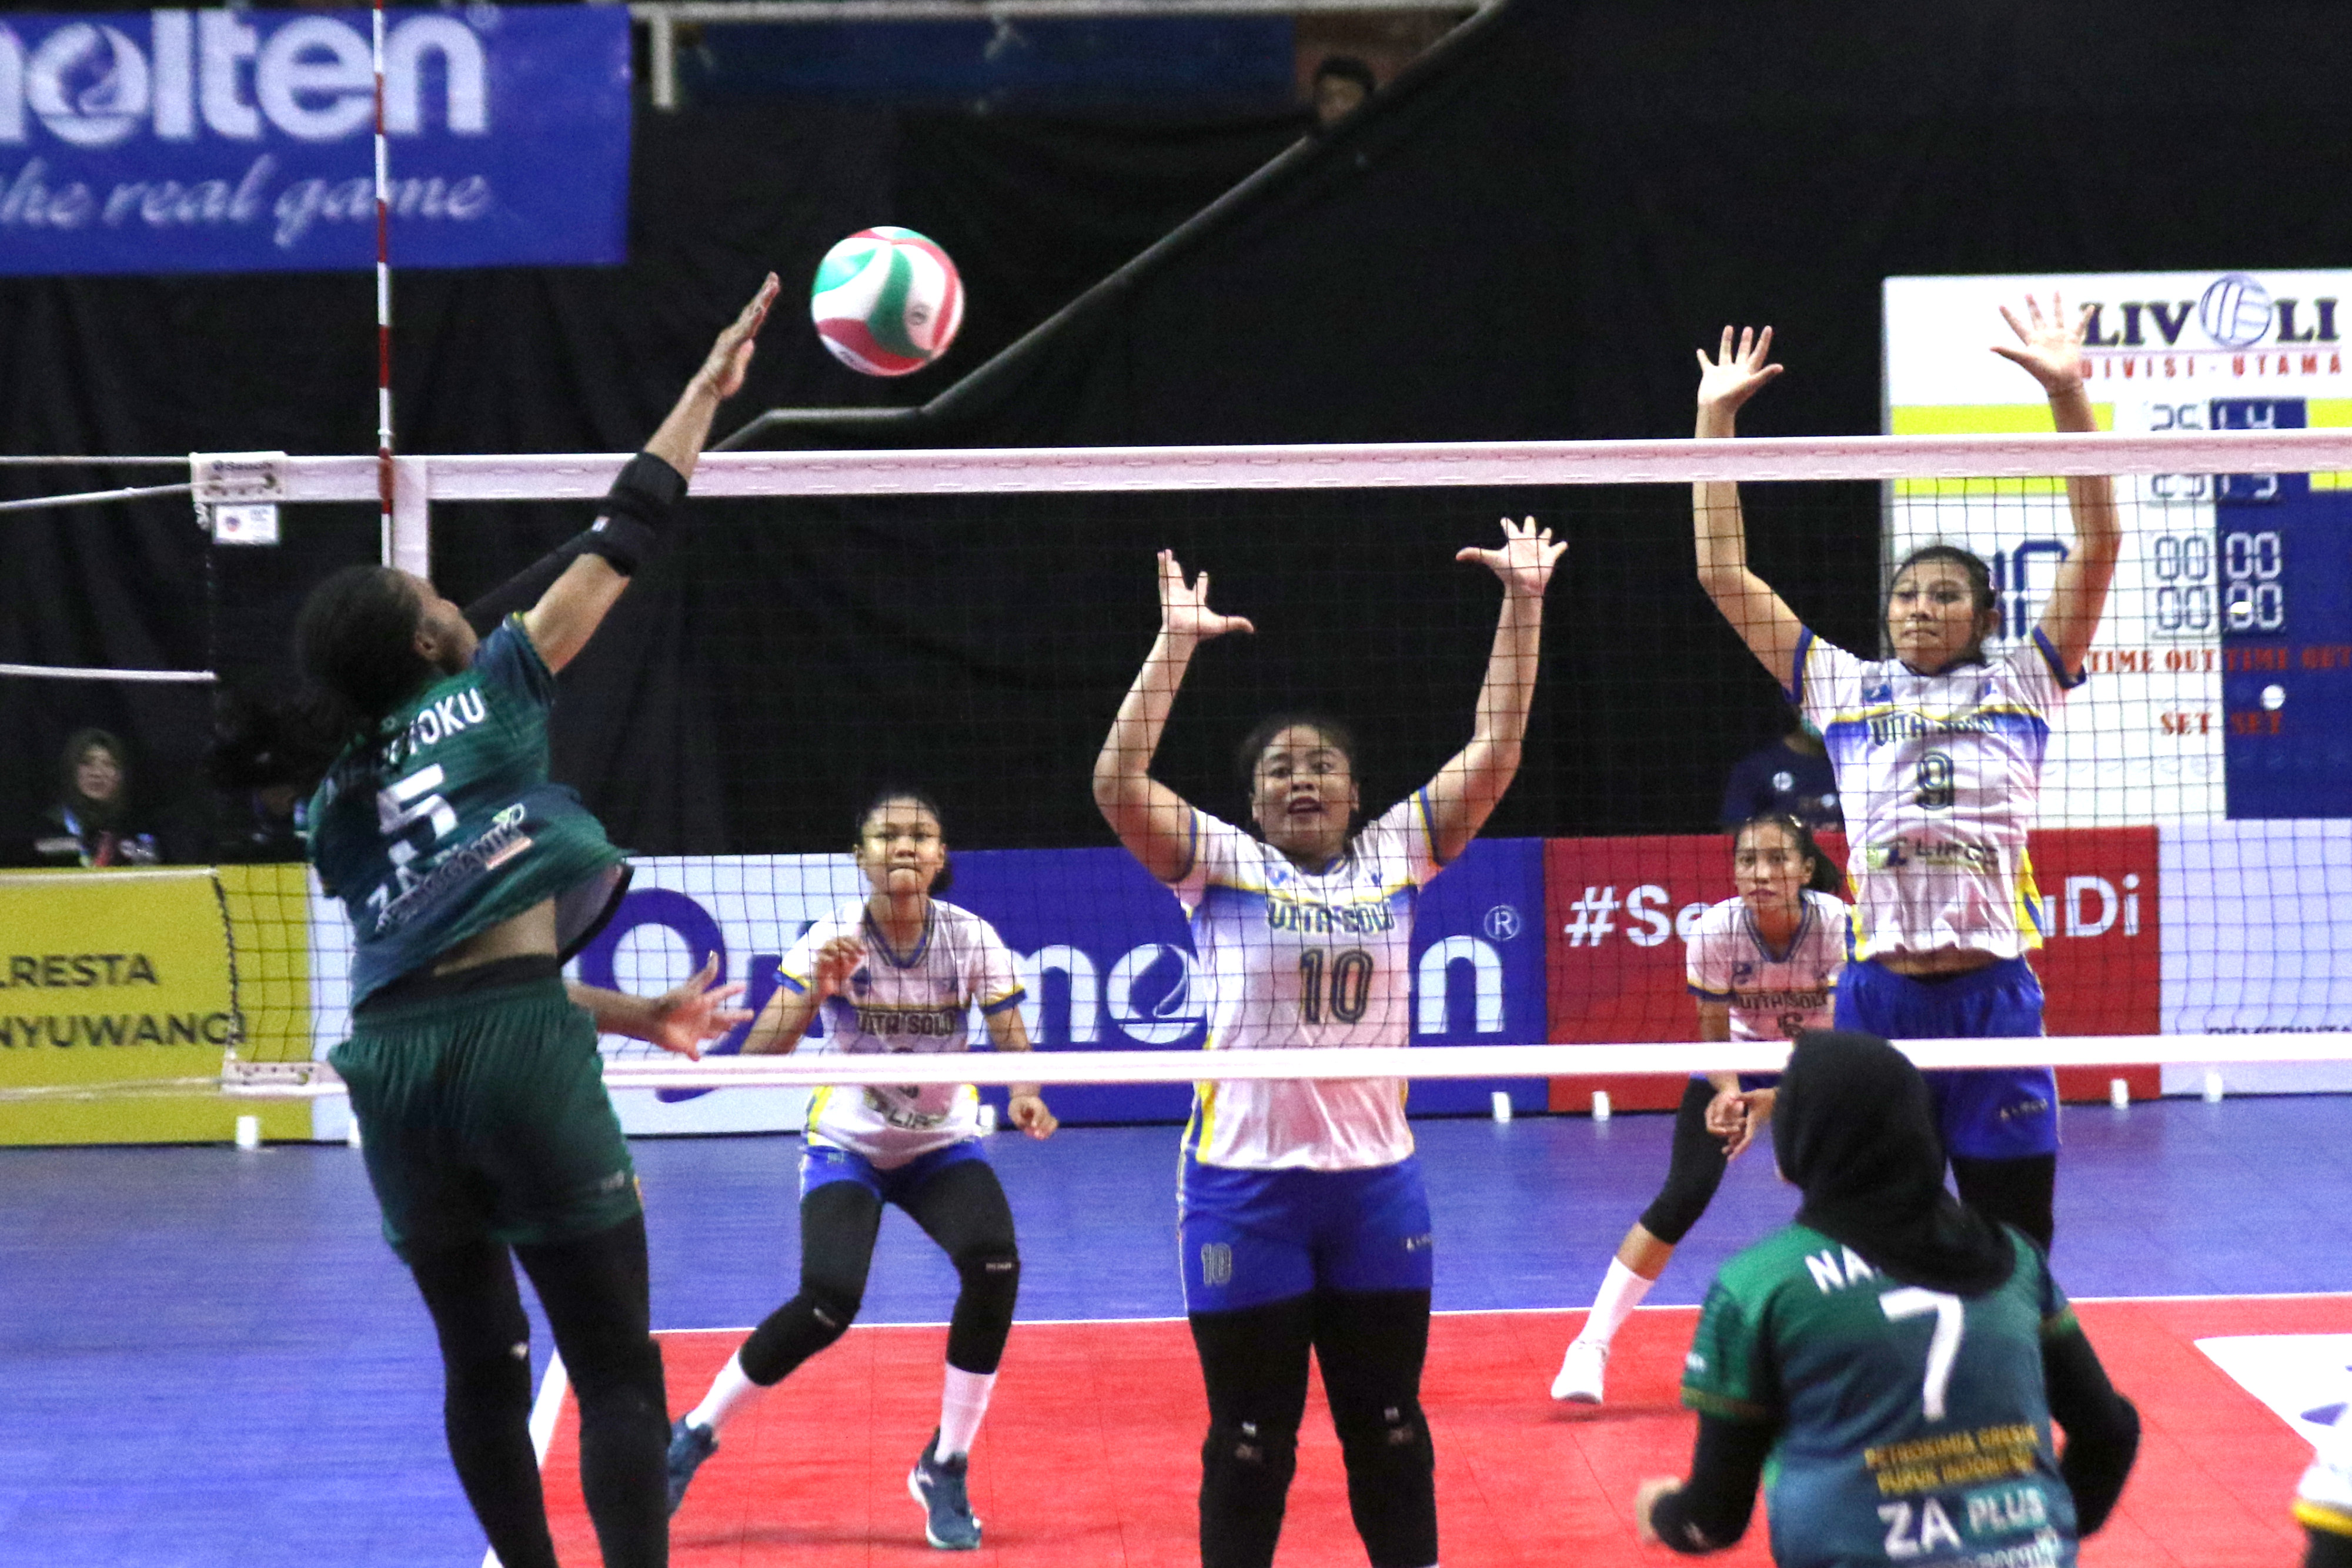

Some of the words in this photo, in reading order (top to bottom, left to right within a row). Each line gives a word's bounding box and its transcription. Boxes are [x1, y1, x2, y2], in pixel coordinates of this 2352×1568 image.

[0, 8, 490, 146] olten
[0, 155, 92, 228] he
[102, 153, 276, 226] real
[273, 176, 492, 248] game
[2233, 353, 2341, 375] UTAMA
[2155, 535, 2209, 580] 00
[2225, 531, 2282, 580] 00
[2157, 586, 2210, 630] 00
[2088, 648, 2154, 673] TIME
[2165, 648, 2217, 673] OUT
[2160, 711, 2211, 735] SET
[376, 763, 459, 865] 5
[0, 954, 159, 987] RESTA
[1299, 947, 1374, 1025] 10
[1879, 1286, 1964, 1422] 7
[1877, 1497, 1963, 1560] ZA
[1966, 1486, 2047, 1533] PLUS
